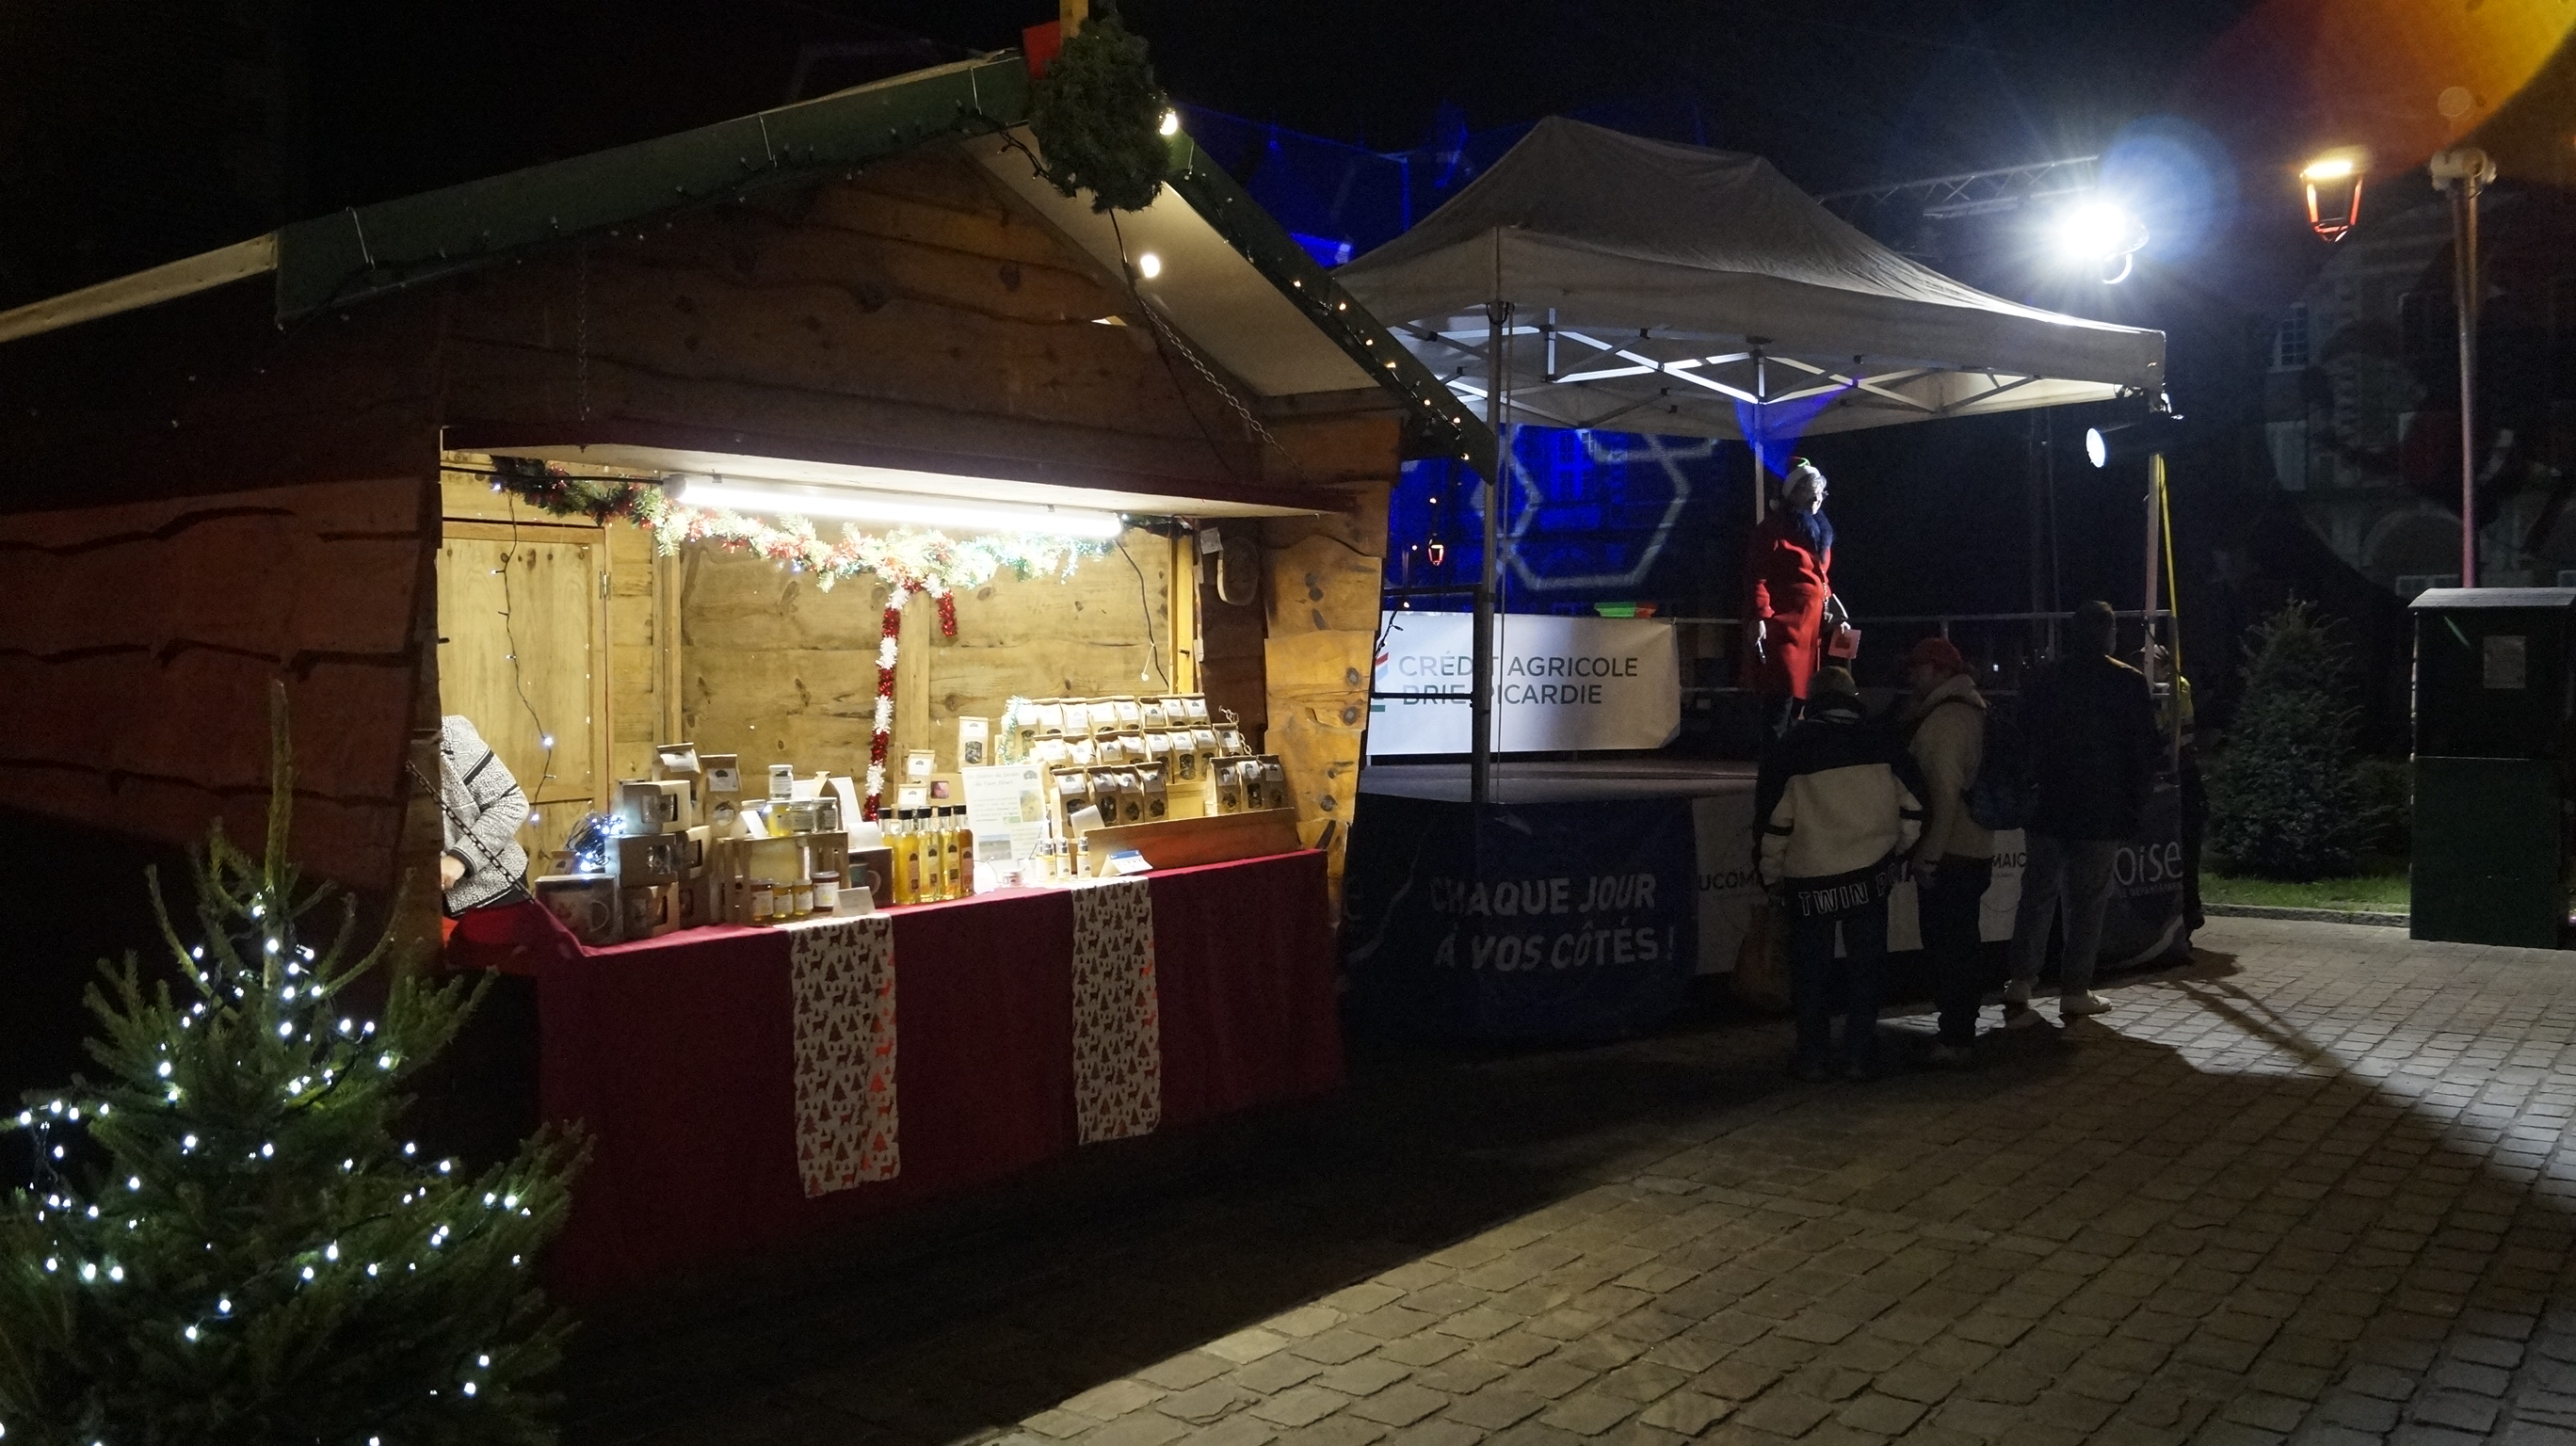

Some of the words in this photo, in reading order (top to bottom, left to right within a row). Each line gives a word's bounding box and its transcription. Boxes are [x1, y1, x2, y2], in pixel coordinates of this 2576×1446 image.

[1398, 650, 1499, 677] CRÉD
[1507, 656, 1638, 678] AGRICOLE
[1403, 683, 1466, 705] BRIE
[1490, 683, 1602, 704] ICARDIE
[1429, 876, 1570, 917] CHAQUE
[1579, 874, 1657, 914] JOUR
[1797, 882, 1870, 917] TWIN
[1471, 933, 1545, 972] VOS
